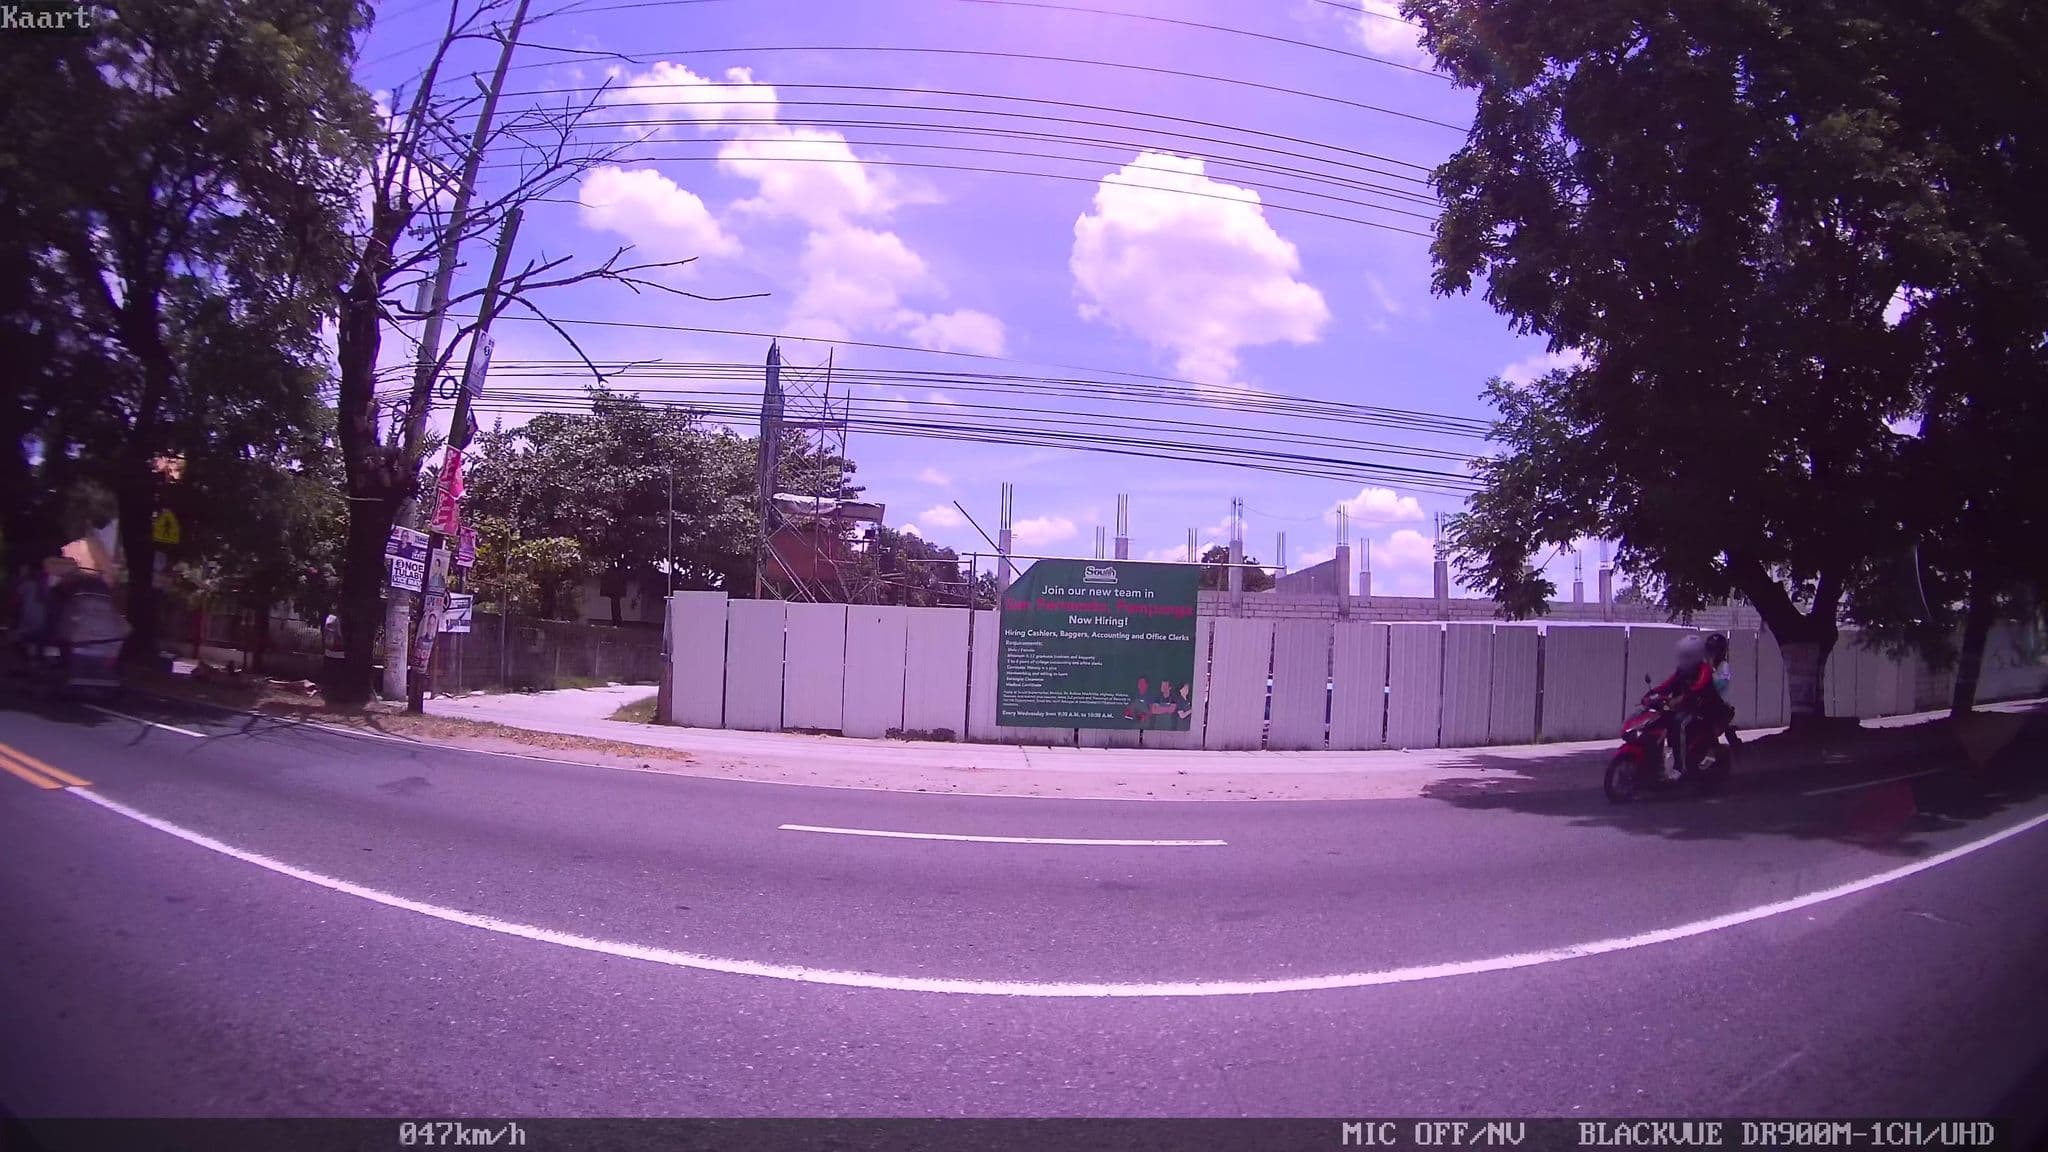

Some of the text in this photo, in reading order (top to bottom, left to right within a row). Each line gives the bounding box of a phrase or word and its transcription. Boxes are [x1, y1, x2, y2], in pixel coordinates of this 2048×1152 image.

[1042, 585, 1154, 598] Join our new team in
[1069, 615, 1128, 627] Now Hiring!
[1005, 629, 1026, 637] Hiring
[1027, 629, 1058, 637] Cashiers,
[1060, 630, 1090, 639] Baggers,
[1091, 632, 1130, 640] Accounting
